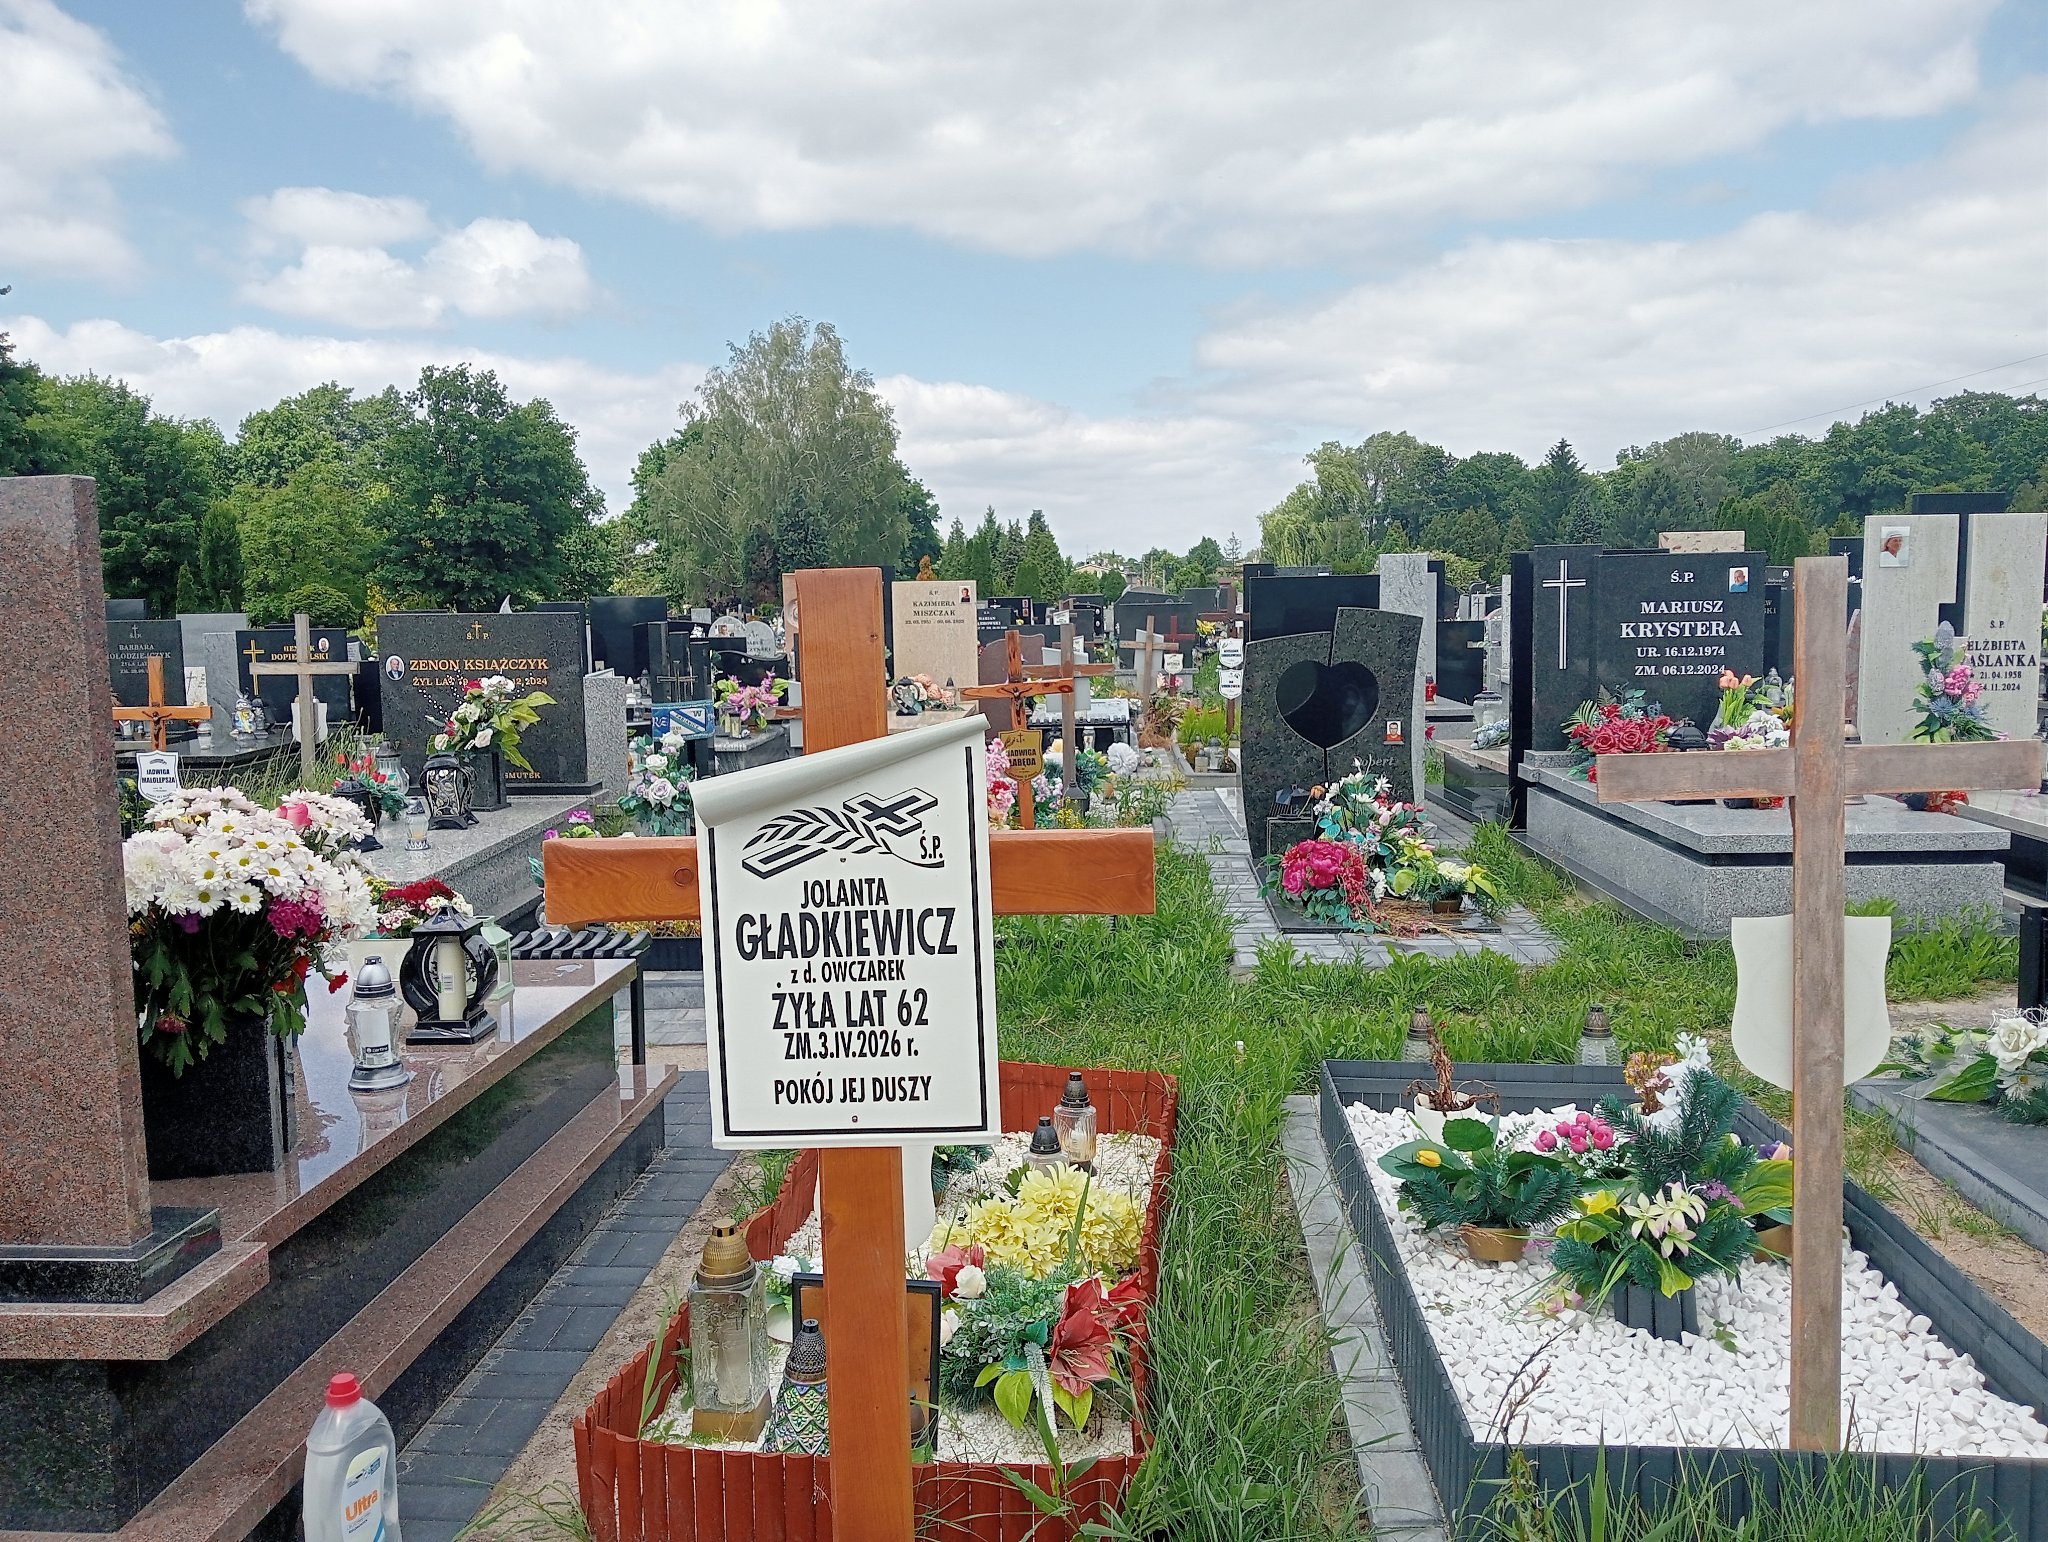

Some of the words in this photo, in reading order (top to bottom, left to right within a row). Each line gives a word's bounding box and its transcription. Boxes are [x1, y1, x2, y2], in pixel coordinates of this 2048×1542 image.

[912, 609, 956, 617] MISZCZAK
[1640, 600, 1724, 614] MARIUSZ
[1619, 620, 1743, 638] KRYSTERA
[118, 644, 155, 652] BARBARA
[1636, 646, 1661, 657] UR.
[1664, 646, 1726, 657] 16.12.1974
[1966, 638, 2026, 651] ELŻBIETA
[409, 660, 460, 671] ZENON
[464, 657, 549, 671] KSIĄŻCZYK
[1969, 652, 2038, 667] AŚLANKA
[1634, 664, 1659, 676] ZM.
[1662, 664, 1726, 675] 06.12.2024
[1979, 682, 2021, 692] 4.11.2024
[920, 829, 944, 860] Ś.P.
[800, 878, 889, 909] JOLANTA
[735, 907, 958, 961] GŁADKIEWICZ
[790, 969, 799, 984] z
[803, 961, 817, 984] d.
[821, 959, 906, 983] OWCZAREK
[771, 982, 837, 1030] ŻYŁA
[844, 989, 888, 1028] LAT
[897, 987, 929, 1027] 62
[783, 1029, 901, 1060] ZM.3.IV.2026
[907, 1037, 919, 1057] r.
[773, 1071, 834, 1105] POKÓJ
[839, 1077, 866, 1103] JEJ
[871, 1075, 932, 1103] DUSZY
[345, 1489, 378, 1521] Ultra
